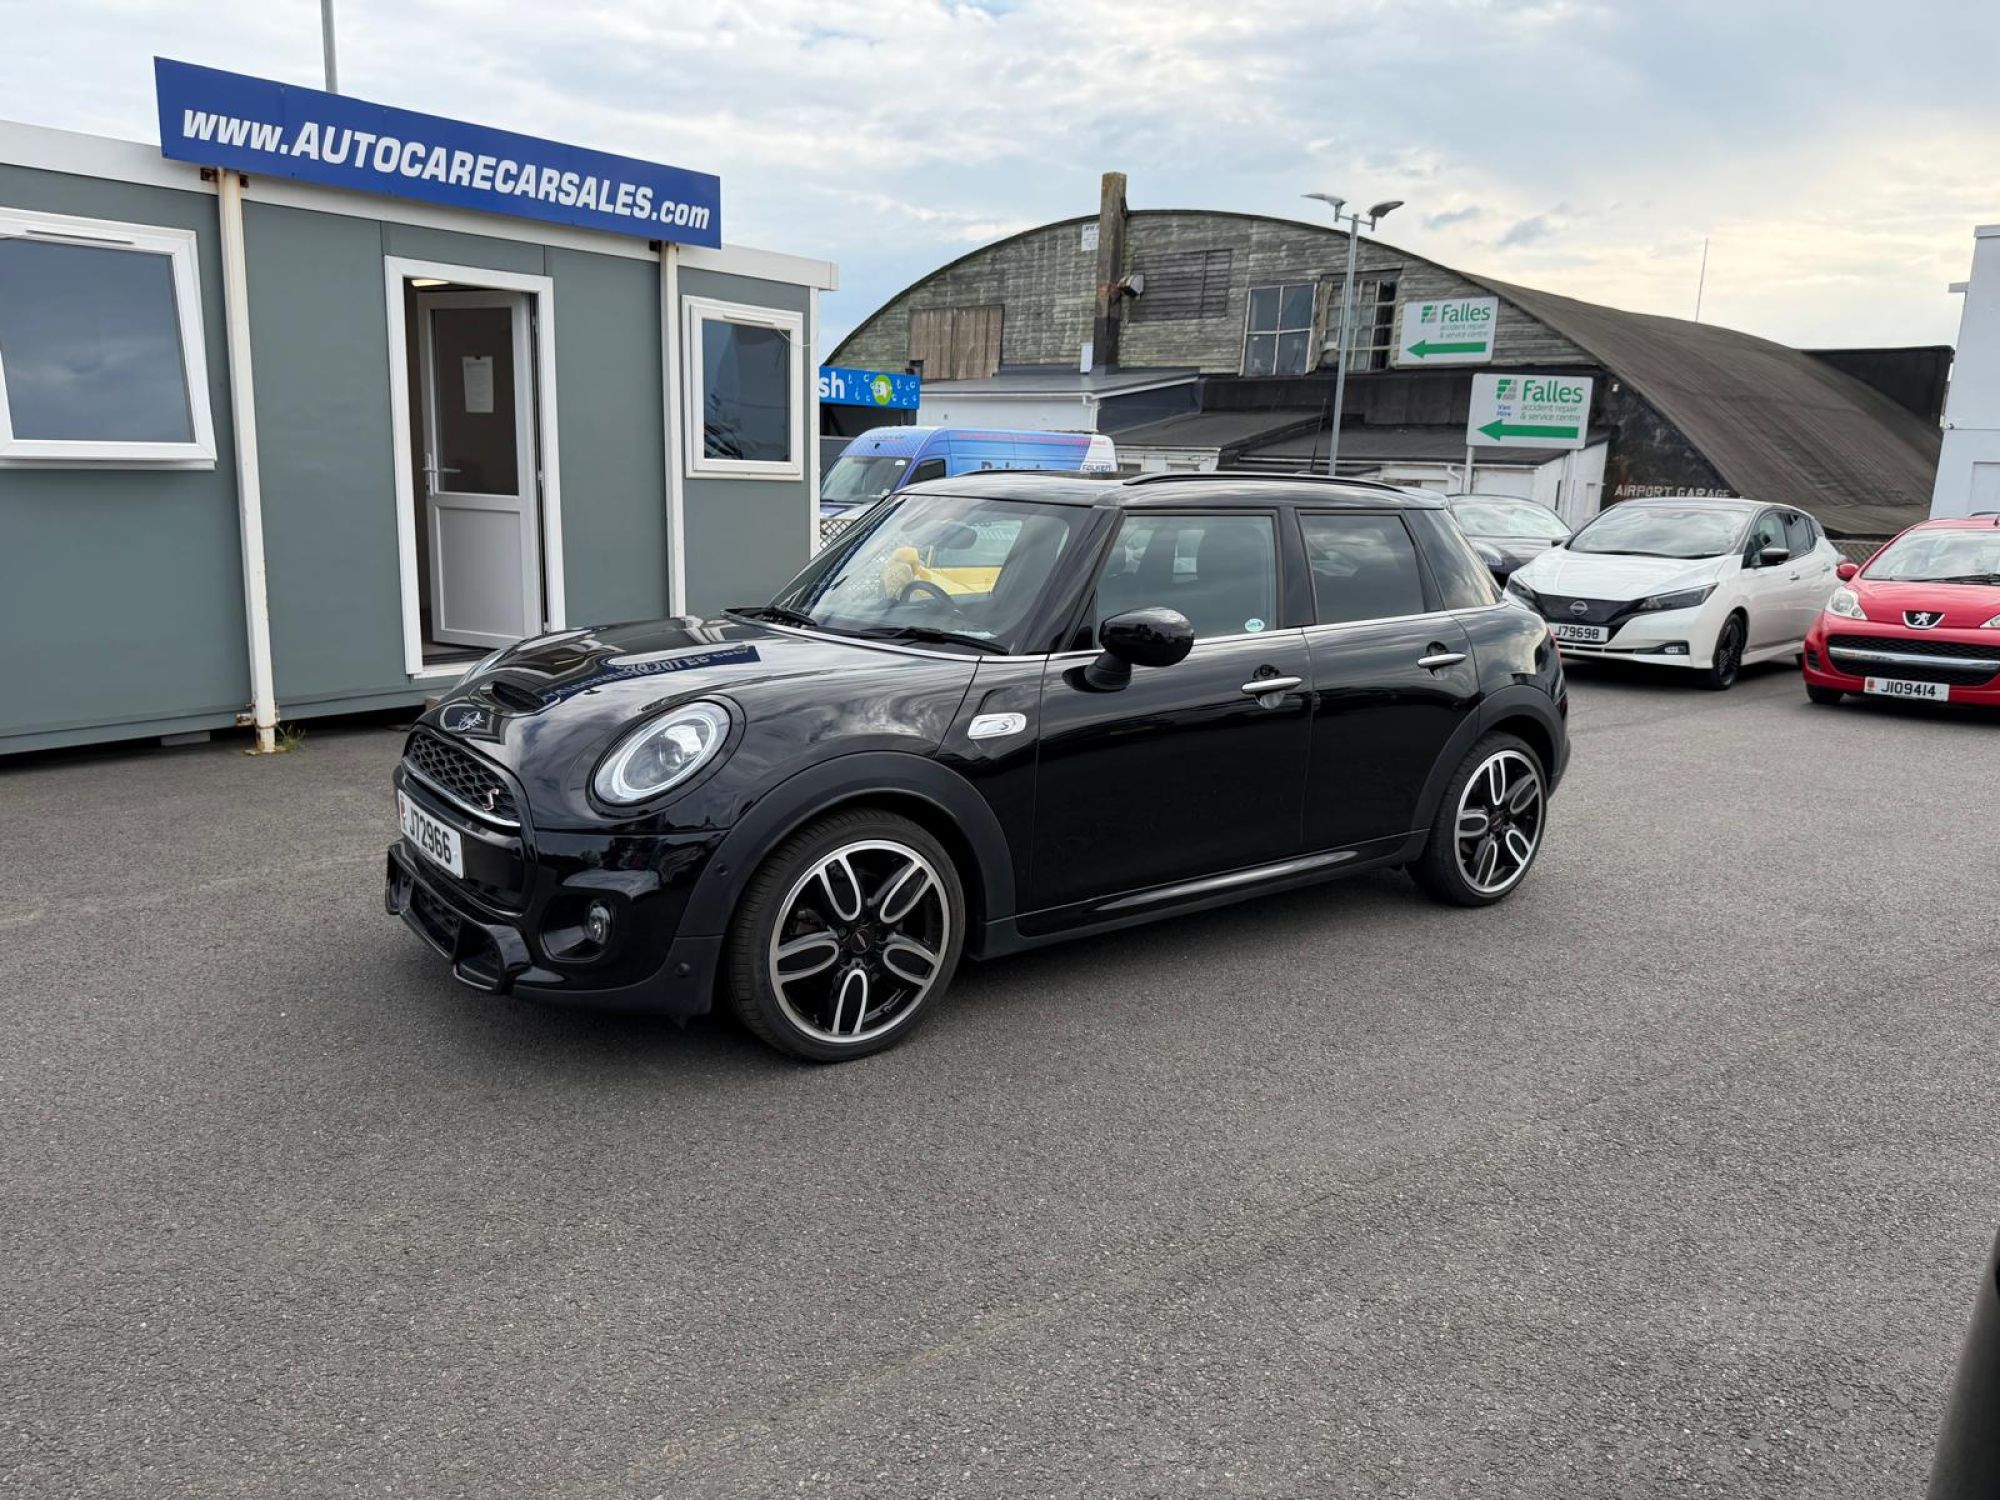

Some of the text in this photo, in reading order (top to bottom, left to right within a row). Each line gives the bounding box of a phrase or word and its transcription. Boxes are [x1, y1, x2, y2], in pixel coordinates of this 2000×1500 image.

[182, 108, 711, 230] www.AUTOCARECARSALES.com
[1441, 303, 1491, 322] Falles
[1522, 380, 1584, 403] Falles
[1520, 404, 1553, 412] accident
[1614, 484, 1730, 498] AIRPORT GARAGE
[1554, 625, 1600, 640] J79698
[410, 806, 452, 865] J72966
